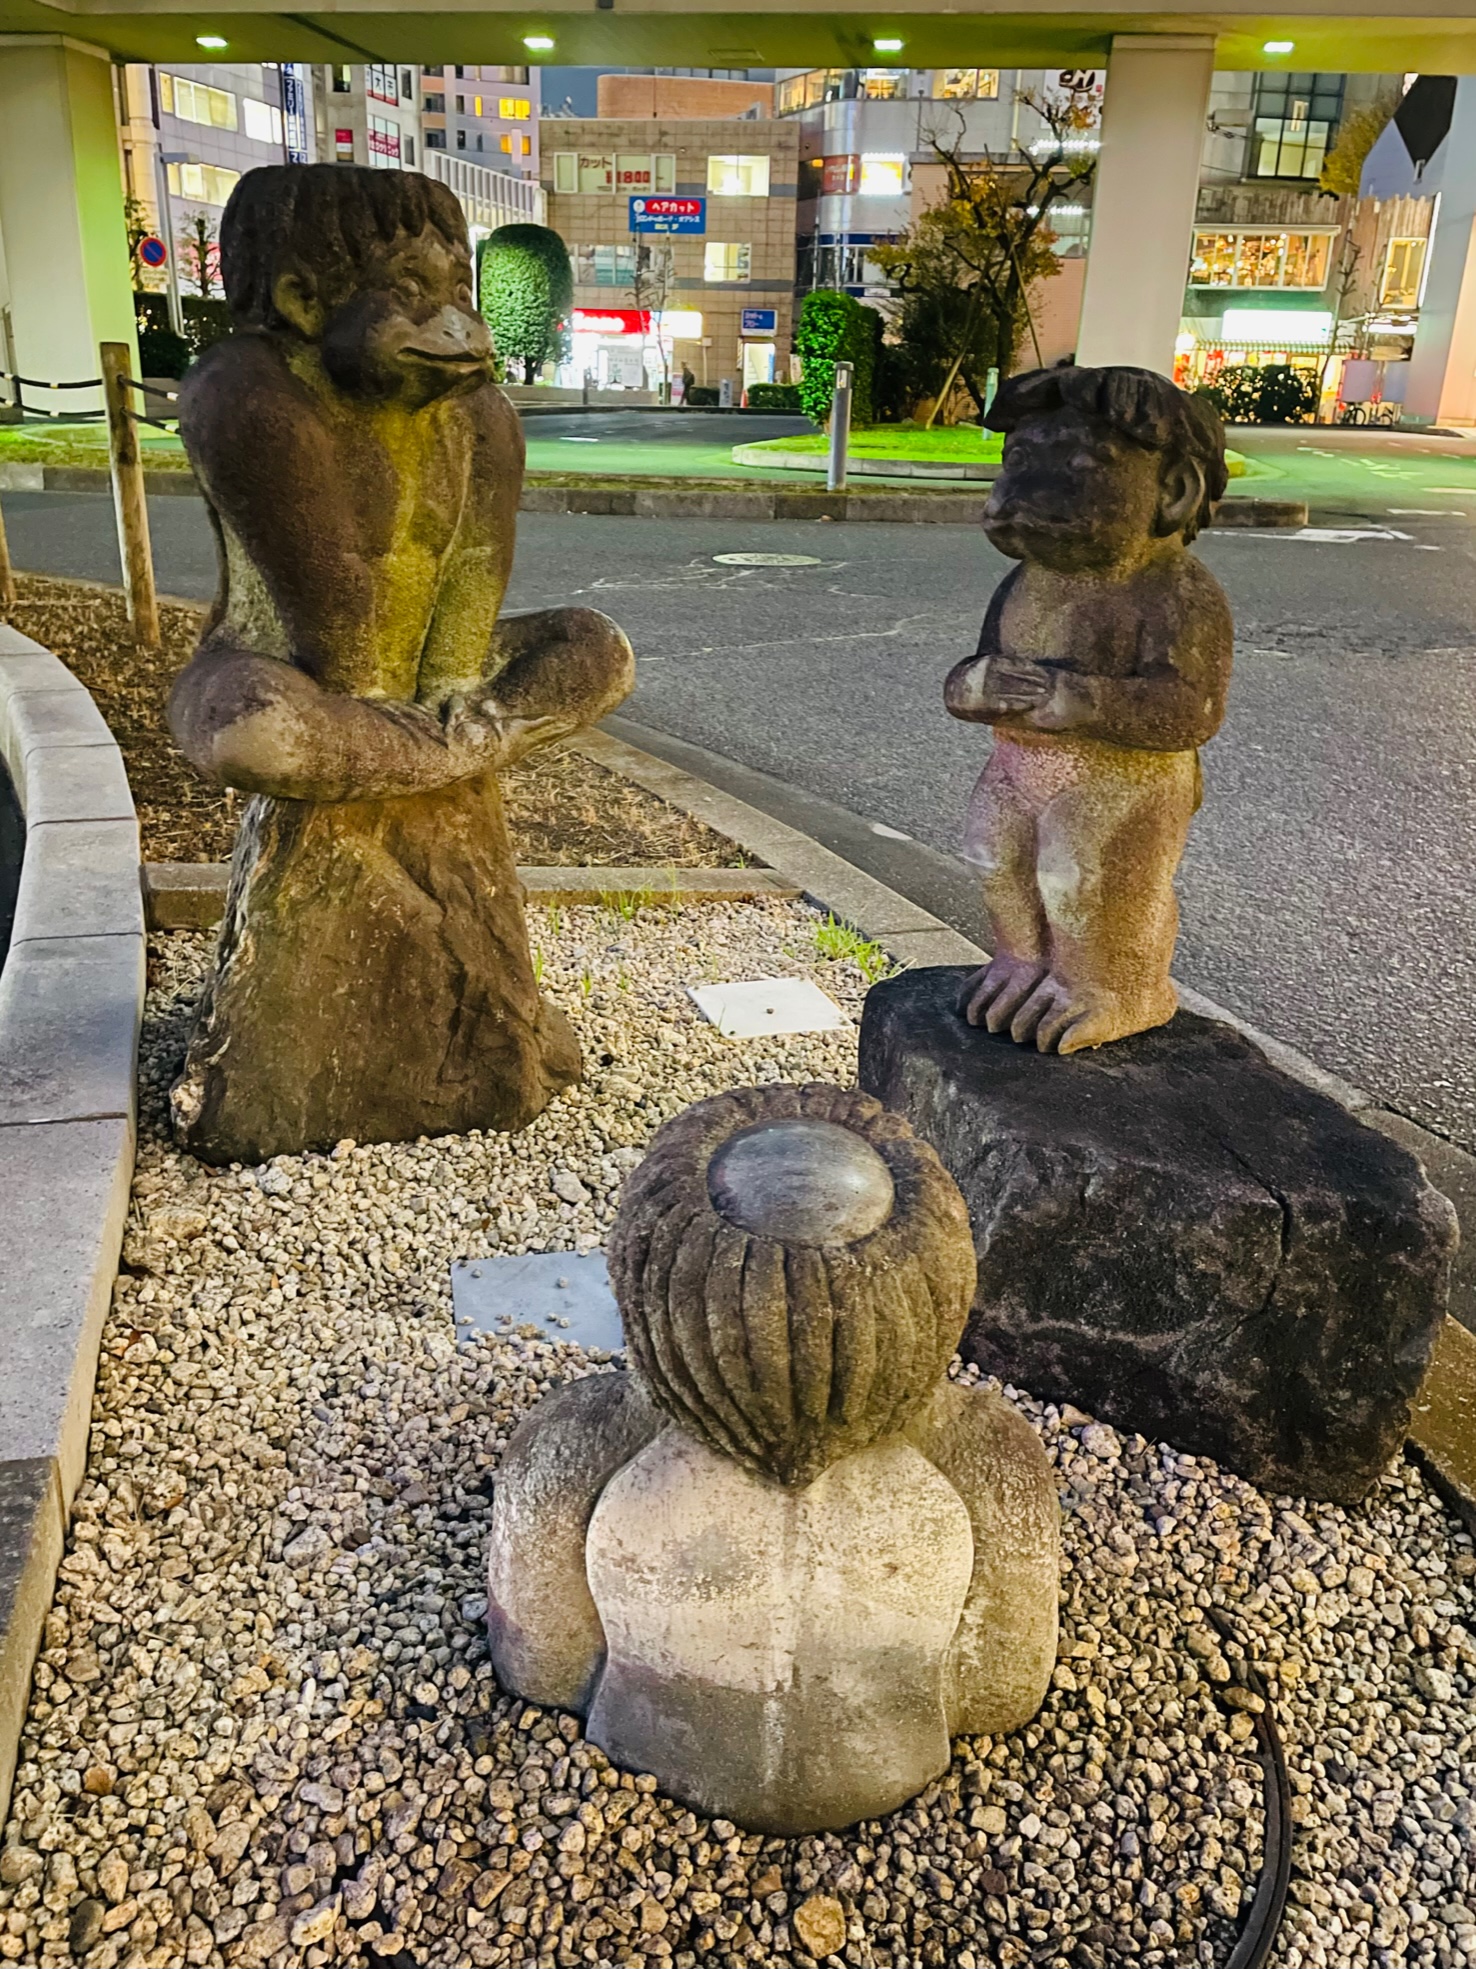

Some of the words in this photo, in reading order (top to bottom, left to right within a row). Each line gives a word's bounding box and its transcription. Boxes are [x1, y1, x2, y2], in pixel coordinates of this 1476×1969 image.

[579, 156, 612, 169] カット
[651, 201, 695, 213] ヘアカット
